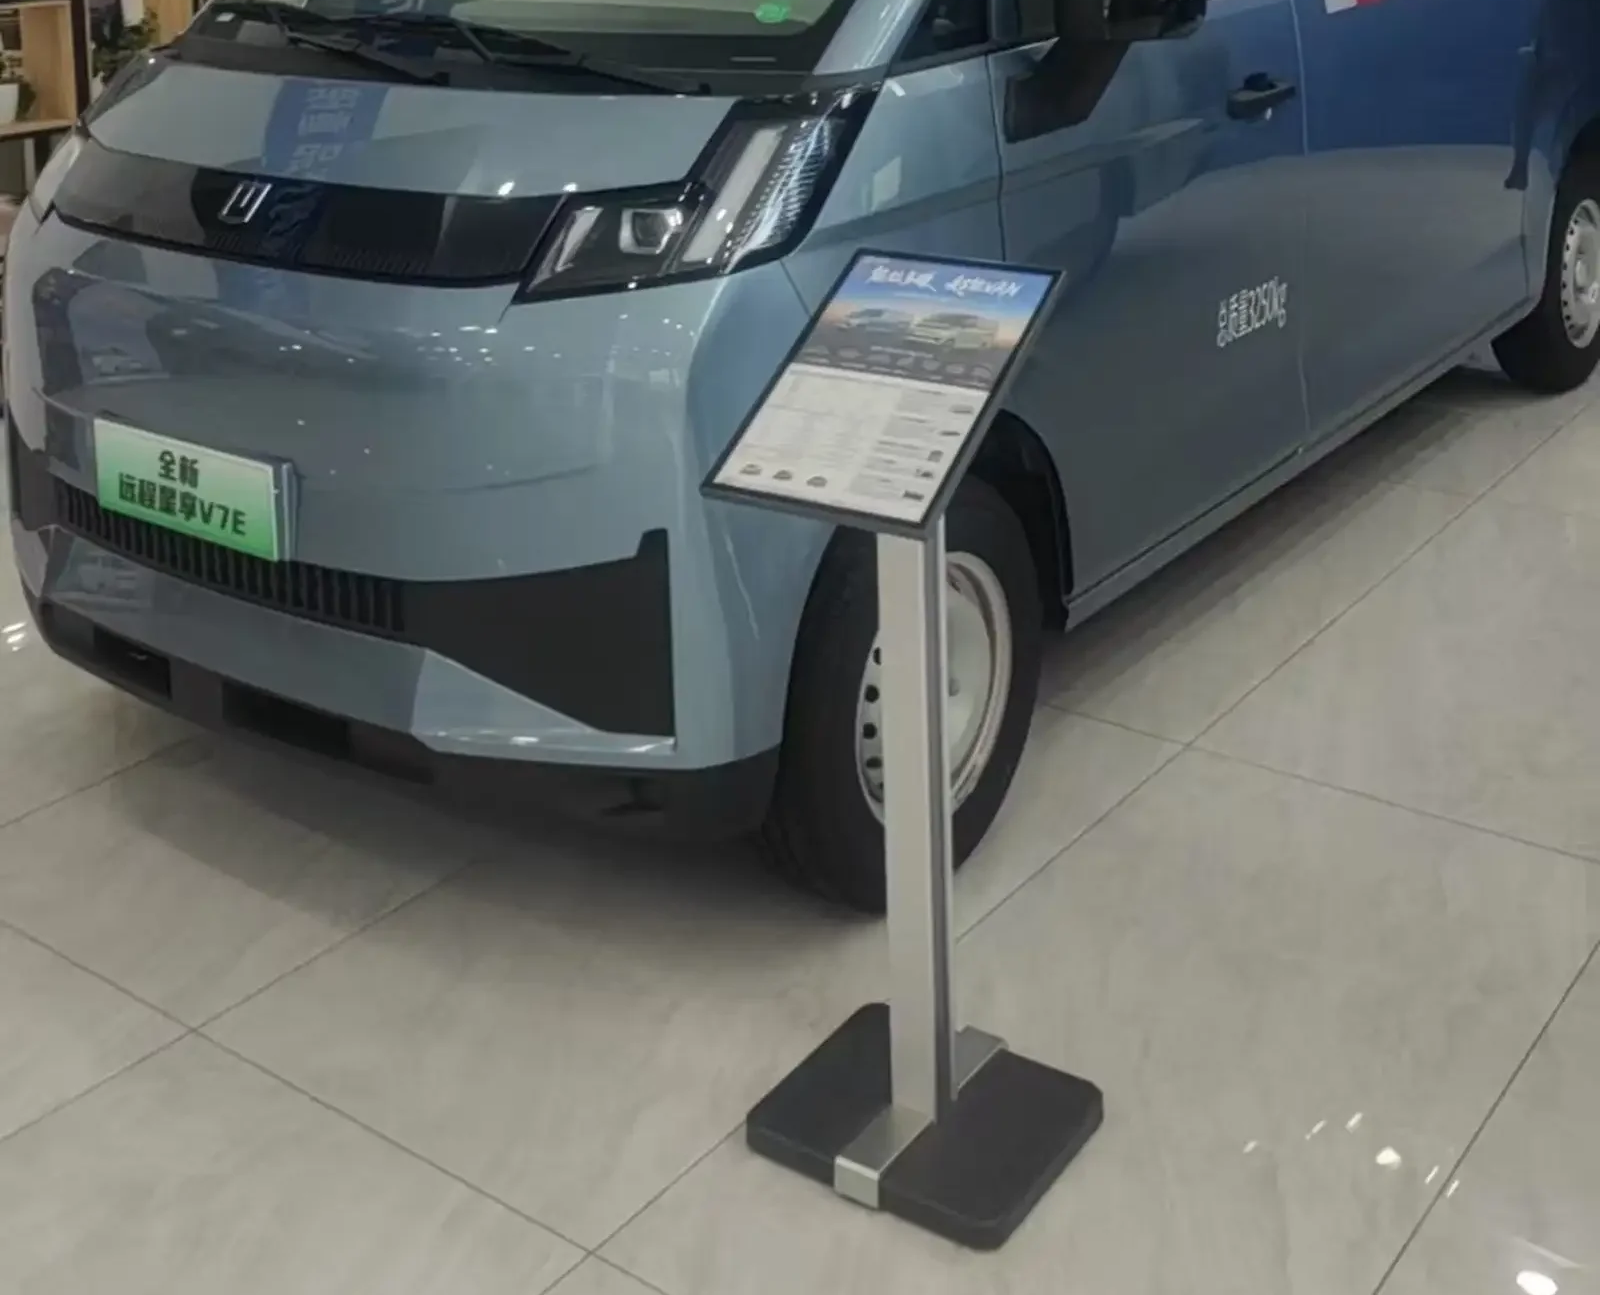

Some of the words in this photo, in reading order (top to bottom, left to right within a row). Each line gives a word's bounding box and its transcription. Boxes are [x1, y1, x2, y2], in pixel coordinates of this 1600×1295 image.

[158, 450, 199, 489] 全新
[118, 472, 246, 536] 远程星享V7E
